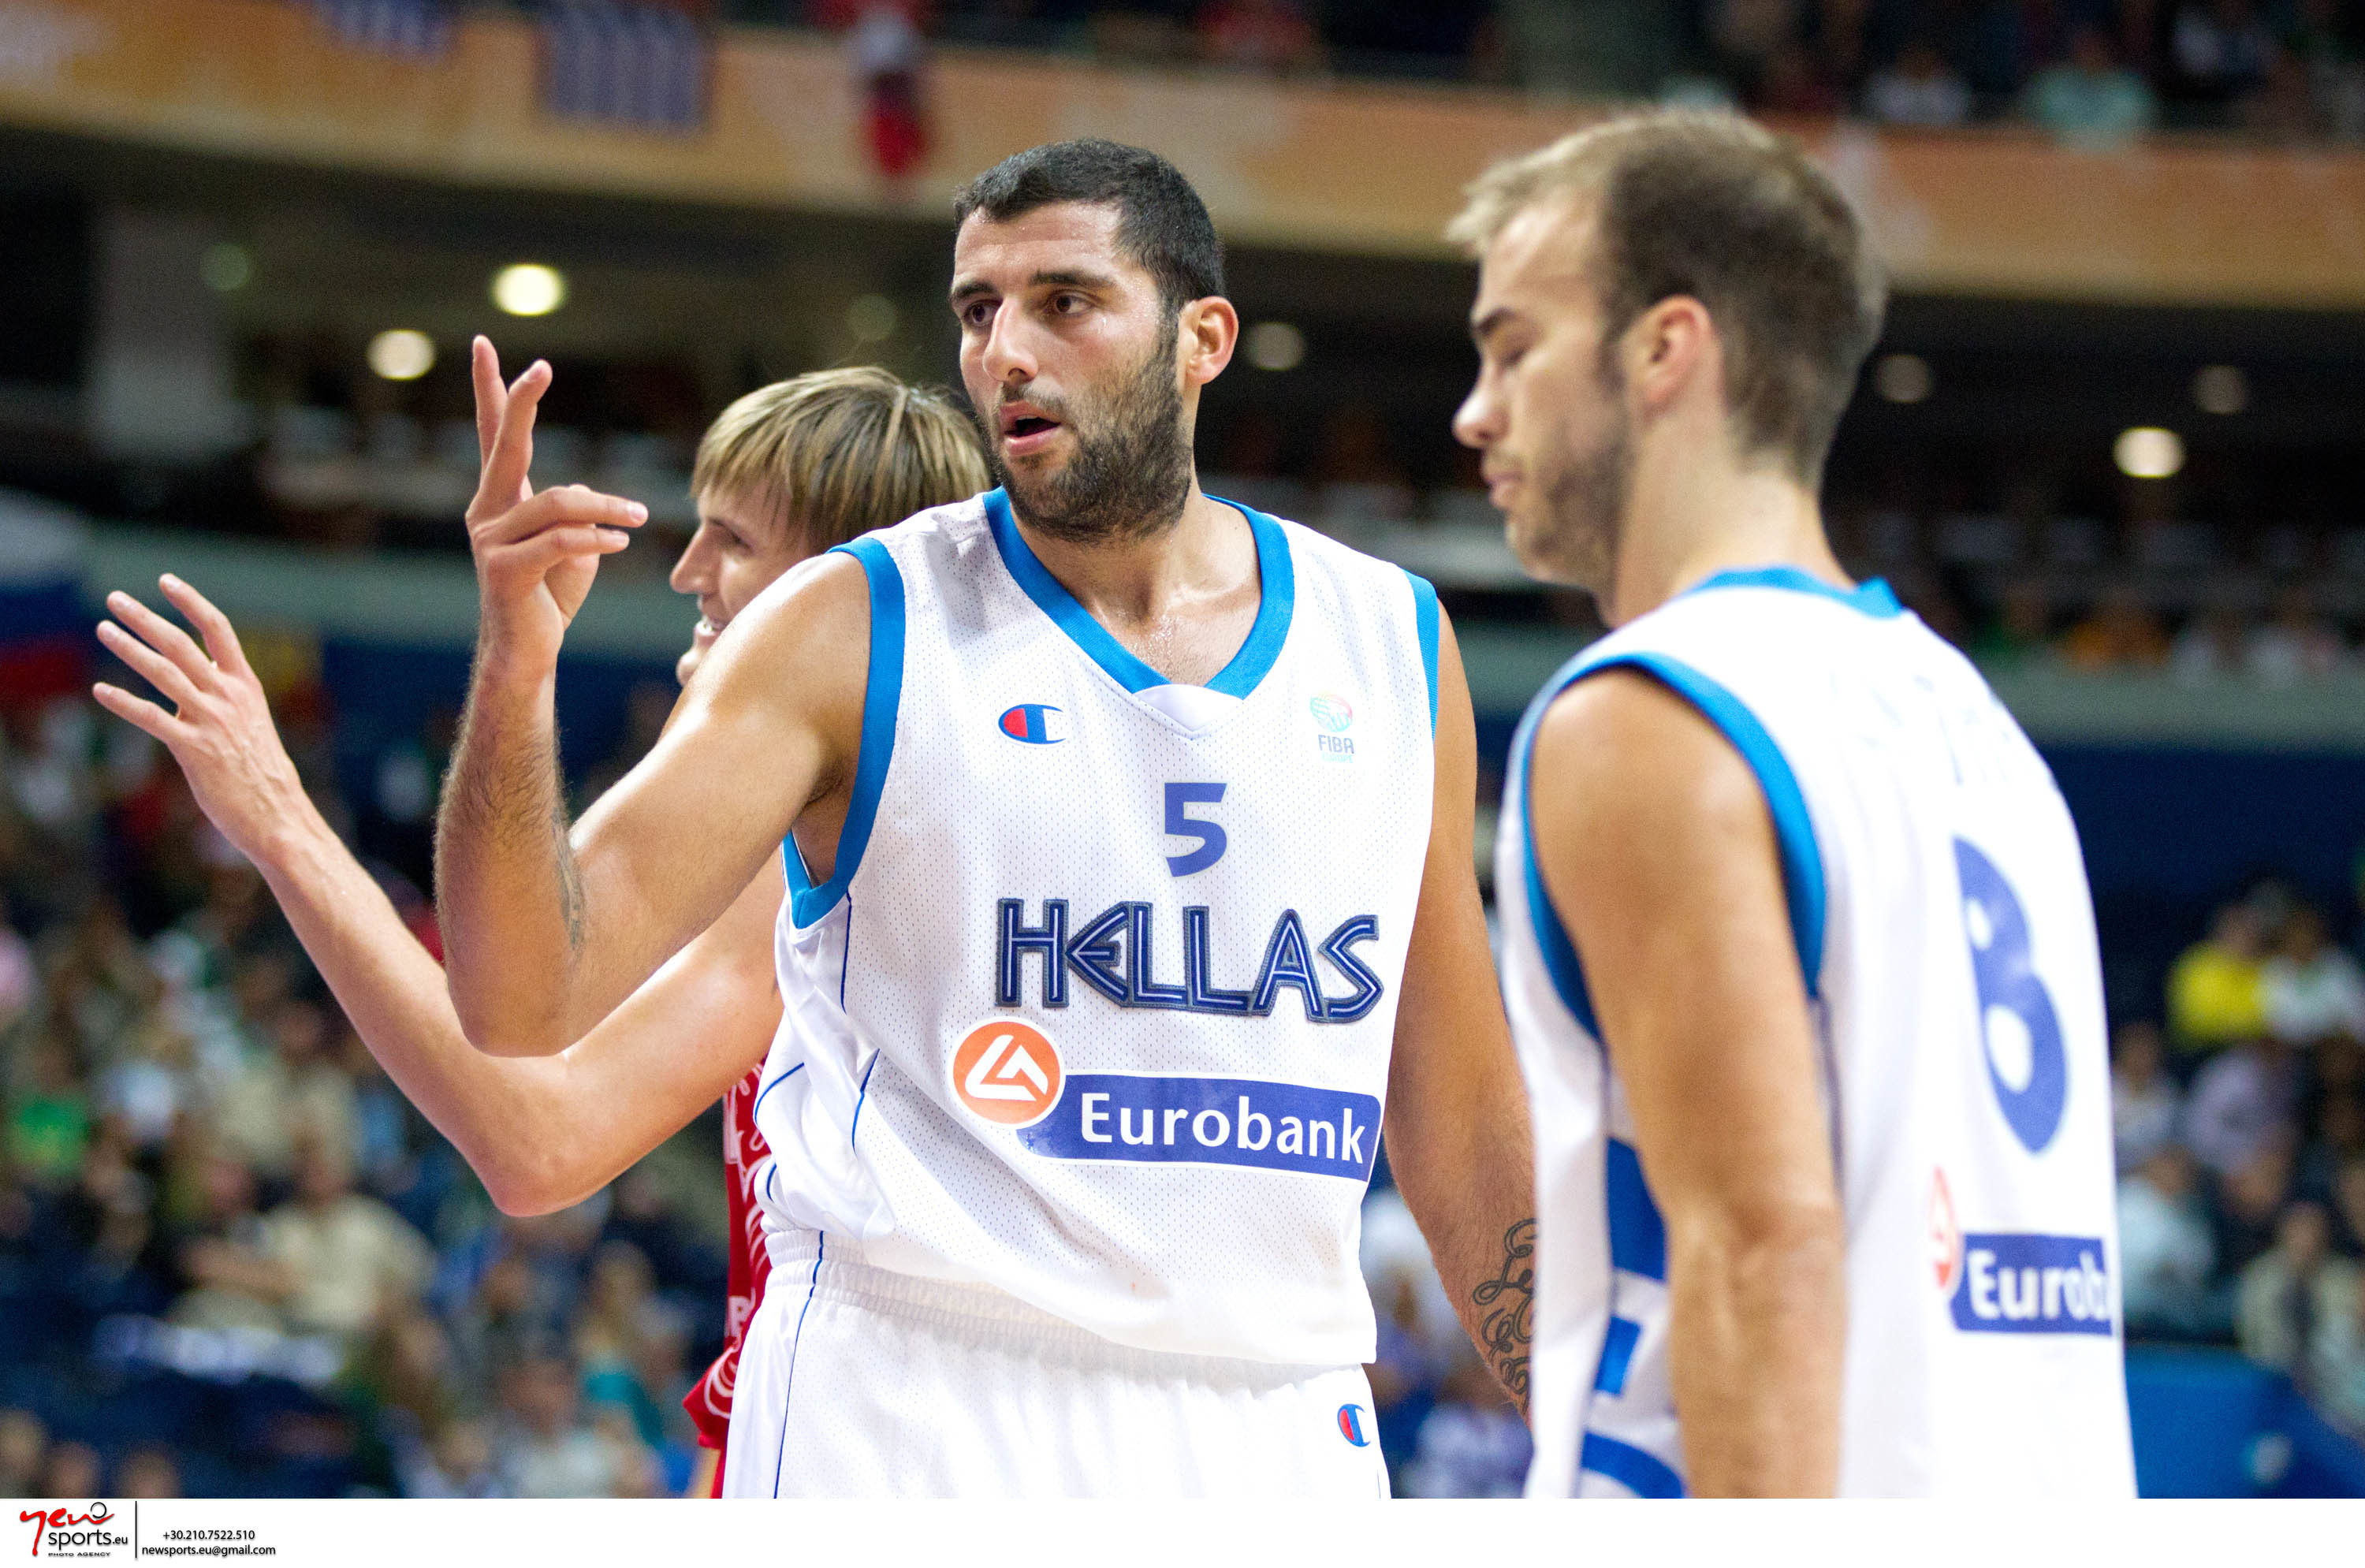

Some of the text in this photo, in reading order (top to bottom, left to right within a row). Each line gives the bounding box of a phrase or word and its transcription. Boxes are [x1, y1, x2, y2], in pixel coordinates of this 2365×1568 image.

[1317, 734, 1354, 754] FIBA
[1164, 781, 1228, 878] 5
[995, 897, 1385, 1024] HELLAS
[1080, 1091, 1367, 1165] Eurobank
